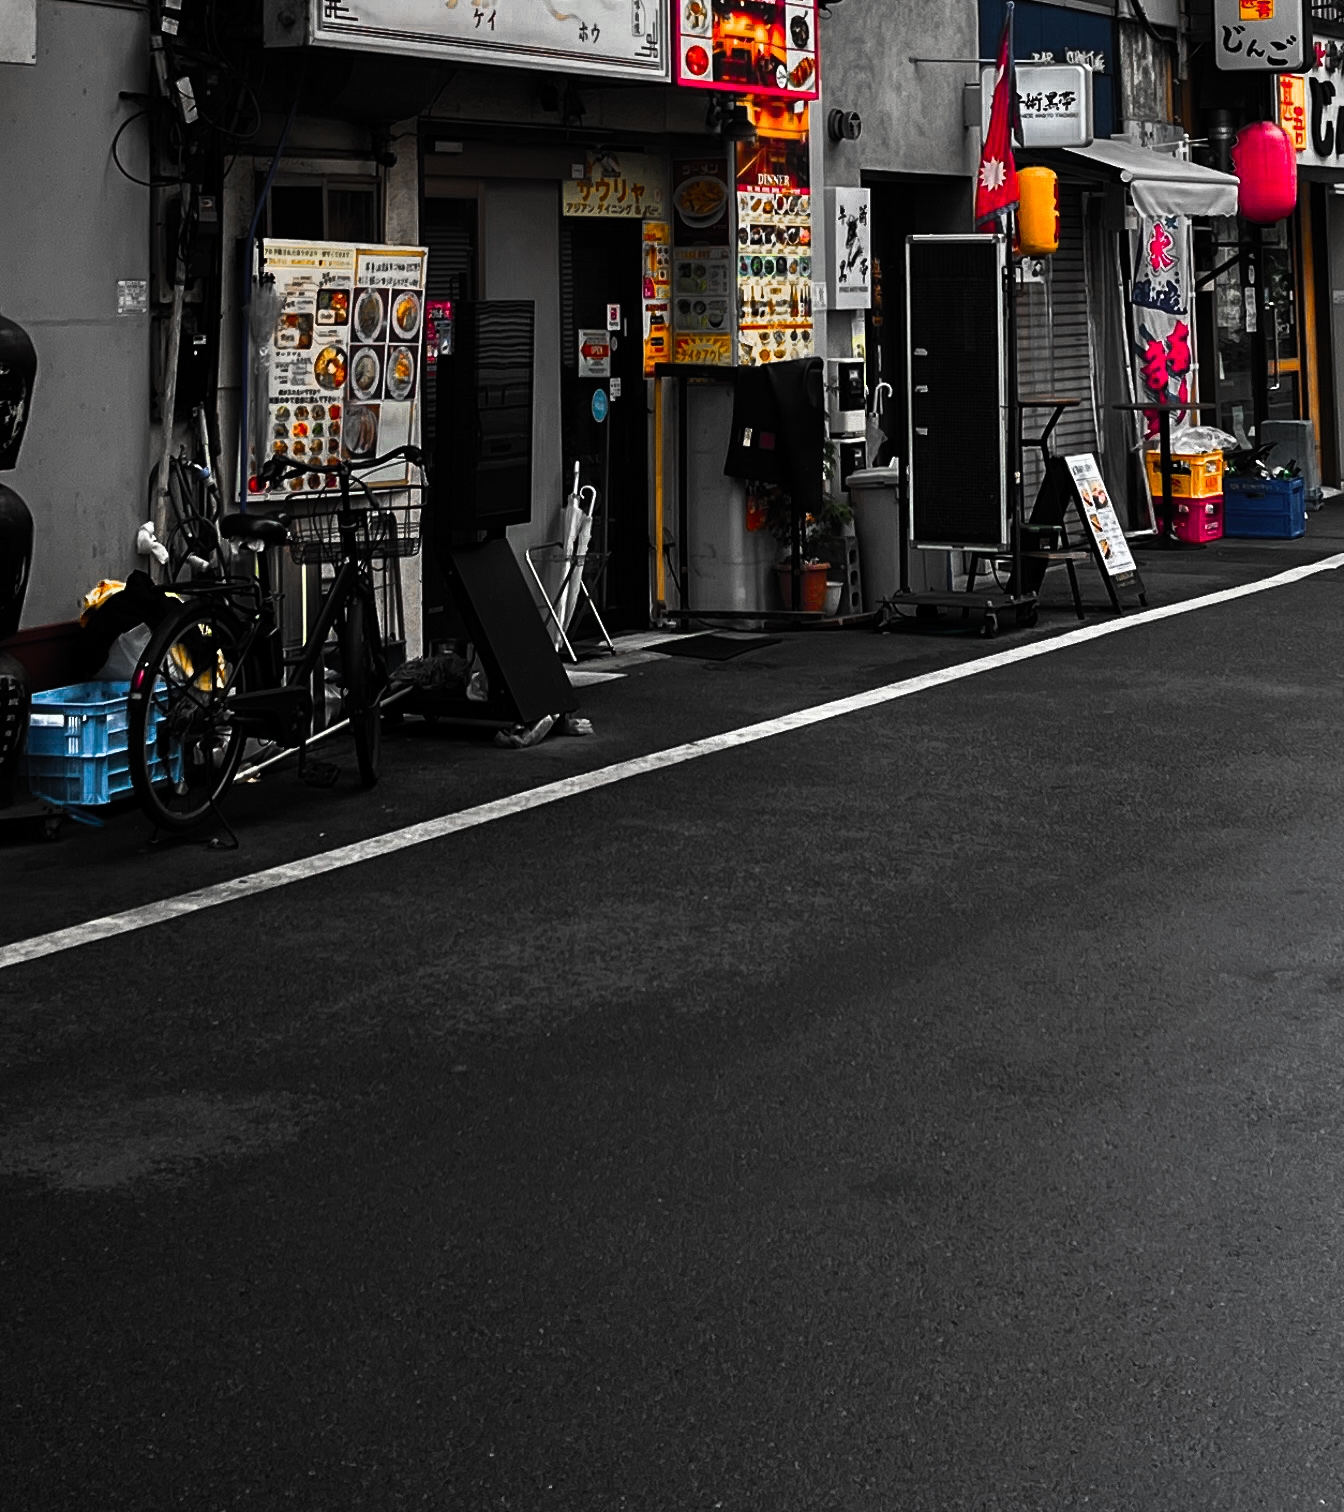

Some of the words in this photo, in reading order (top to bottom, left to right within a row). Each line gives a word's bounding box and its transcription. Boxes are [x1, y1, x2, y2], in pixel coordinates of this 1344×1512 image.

[471, 6, 498, 33] ケイ
[1220, 24, 1298, 67] じんご
[757, 172, 791, 187] DINNER
